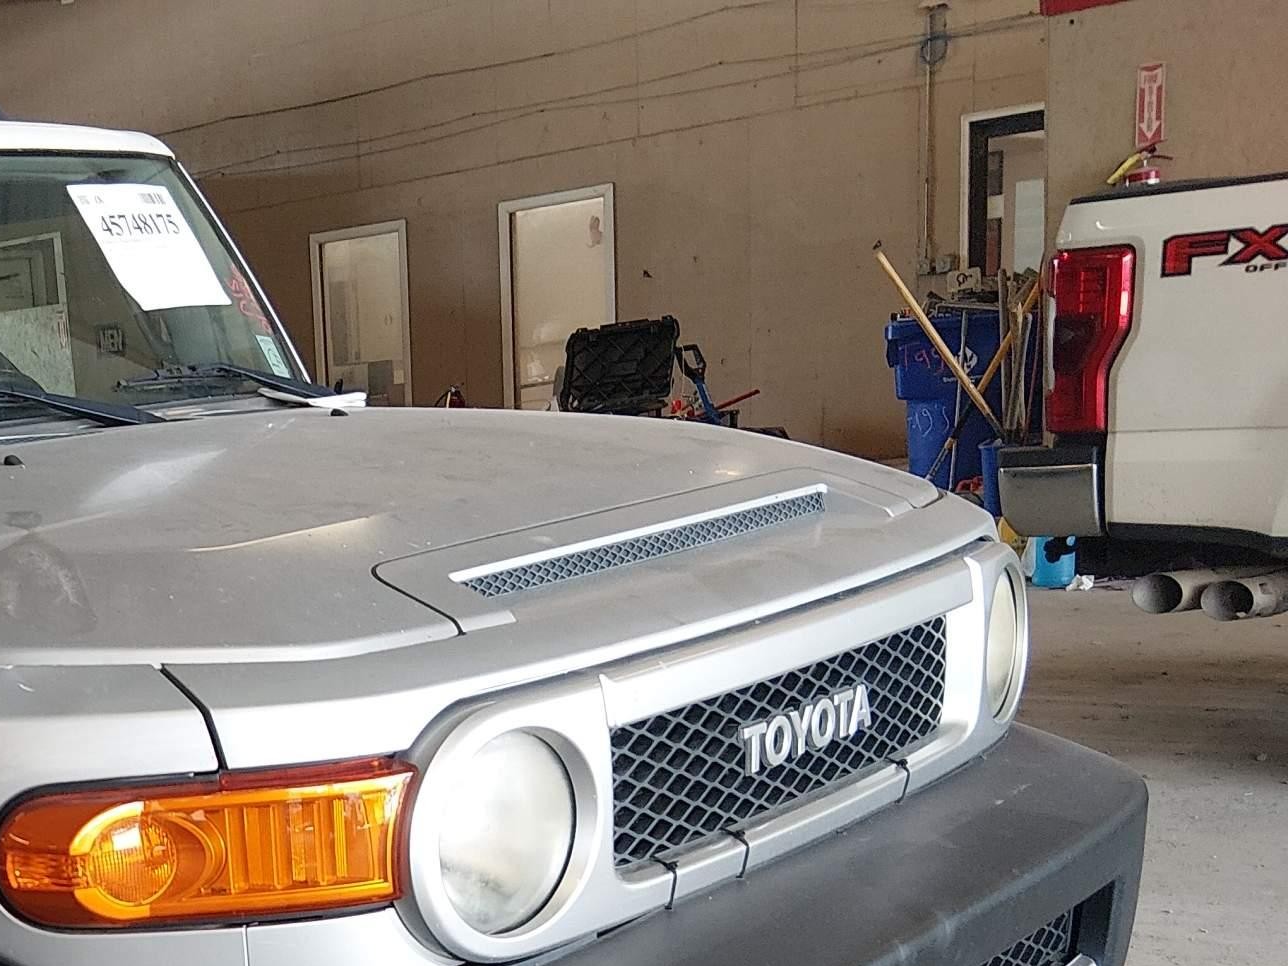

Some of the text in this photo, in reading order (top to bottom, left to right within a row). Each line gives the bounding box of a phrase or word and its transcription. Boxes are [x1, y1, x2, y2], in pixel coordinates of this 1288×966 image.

[101, 213, 180, 236] 45748175
[1244, 262, 1288, 273] OFF
[742, 684, 872, 776] TOYOTA
